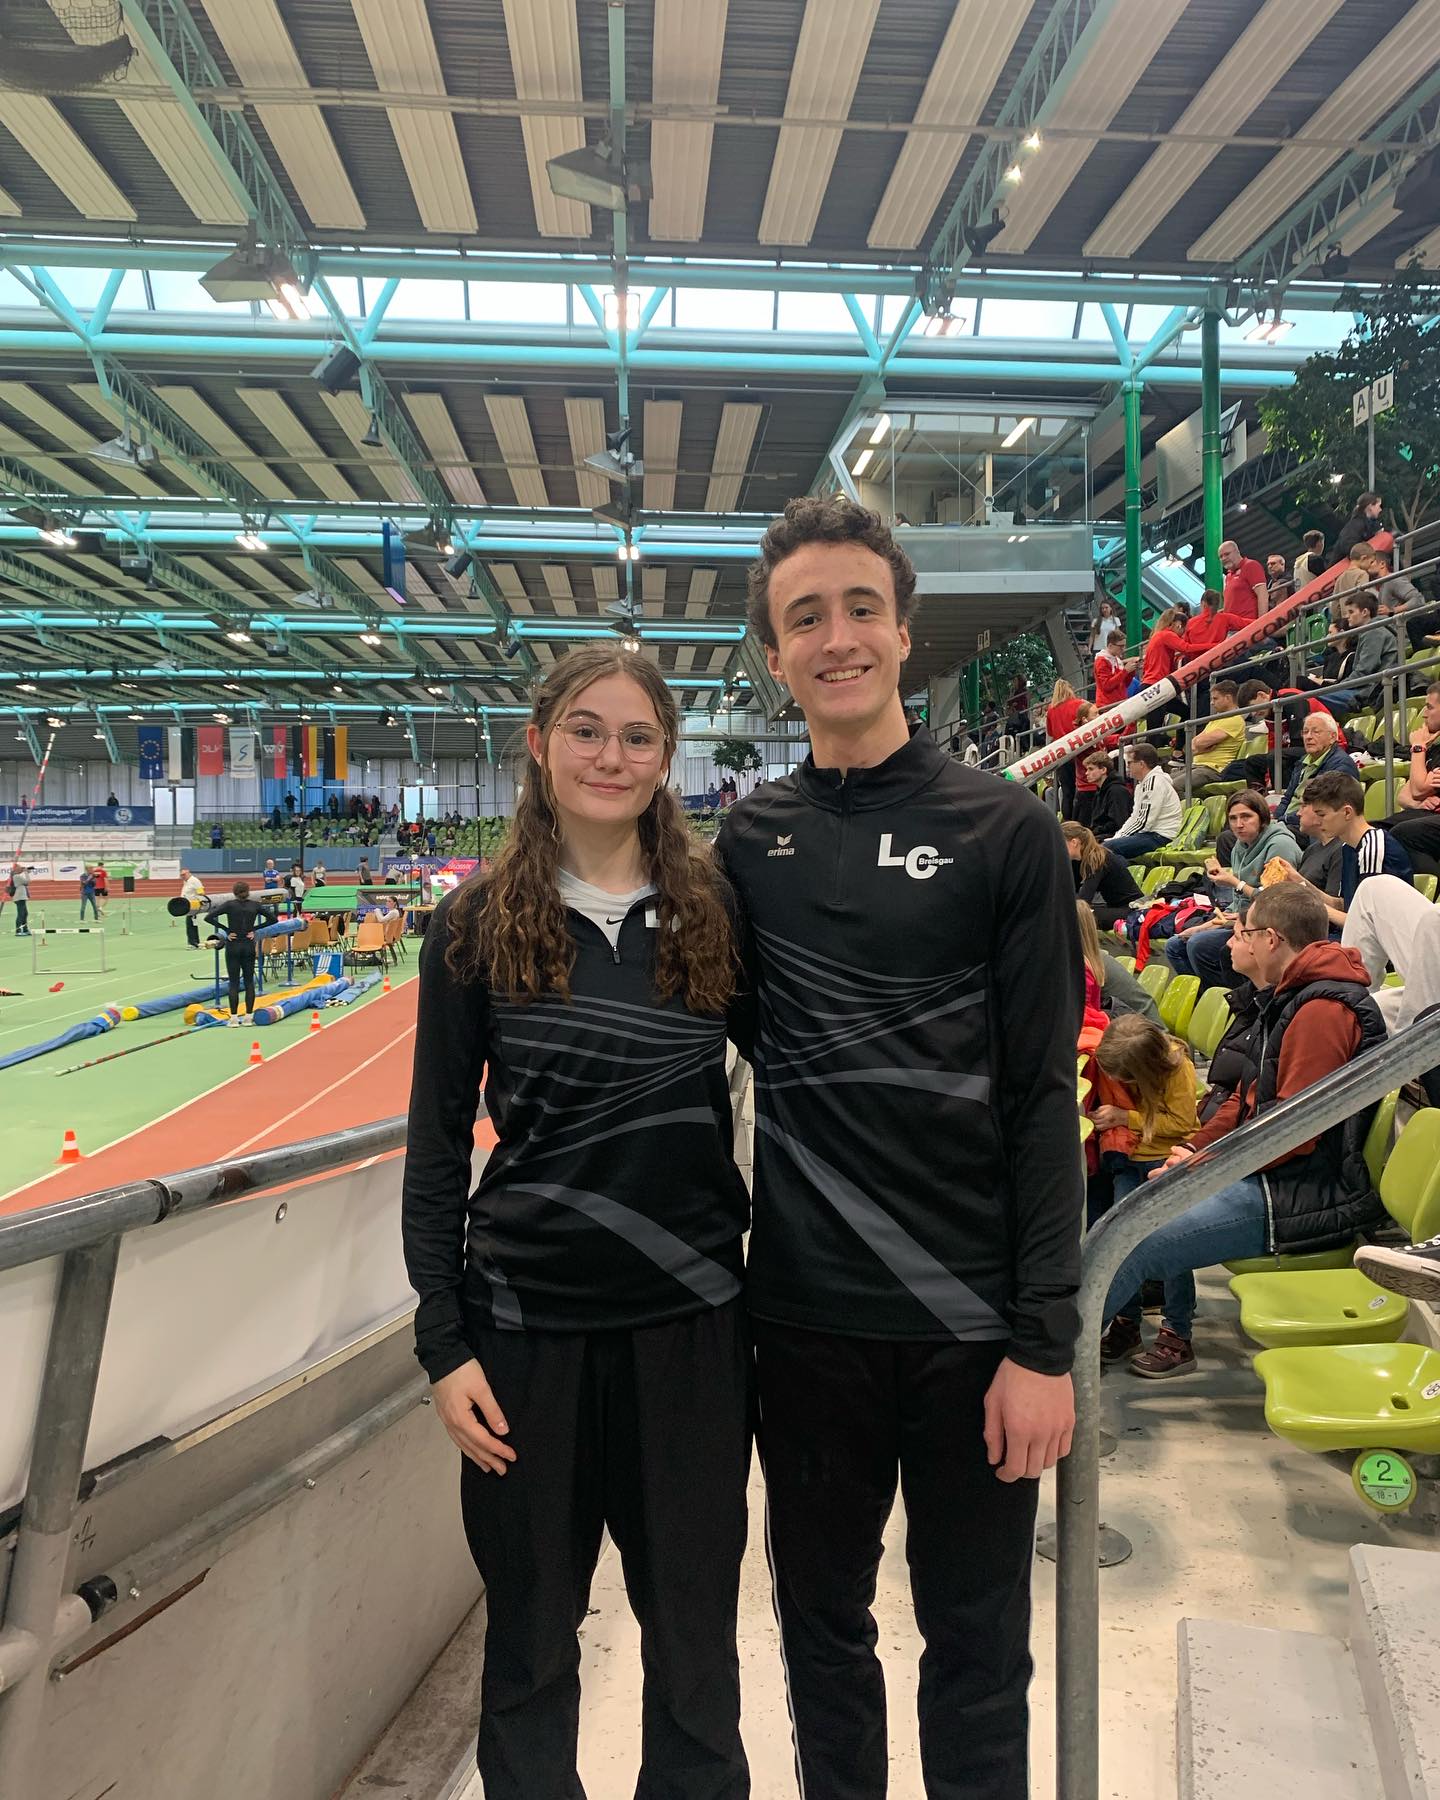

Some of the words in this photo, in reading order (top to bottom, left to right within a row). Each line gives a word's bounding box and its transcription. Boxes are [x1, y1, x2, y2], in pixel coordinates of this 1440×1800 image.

[1377, 379, 1388, 400] U
[1357, 393, 1366, 414] A
[1182, 640, 1248, 689] PACER
[1020, 746, 1067, 778] Luzia
[1066, 713, 1125, 751] Herzig
[767, 847, 795, 857] erima
[1376, 1460, 1393, 1481] 2
